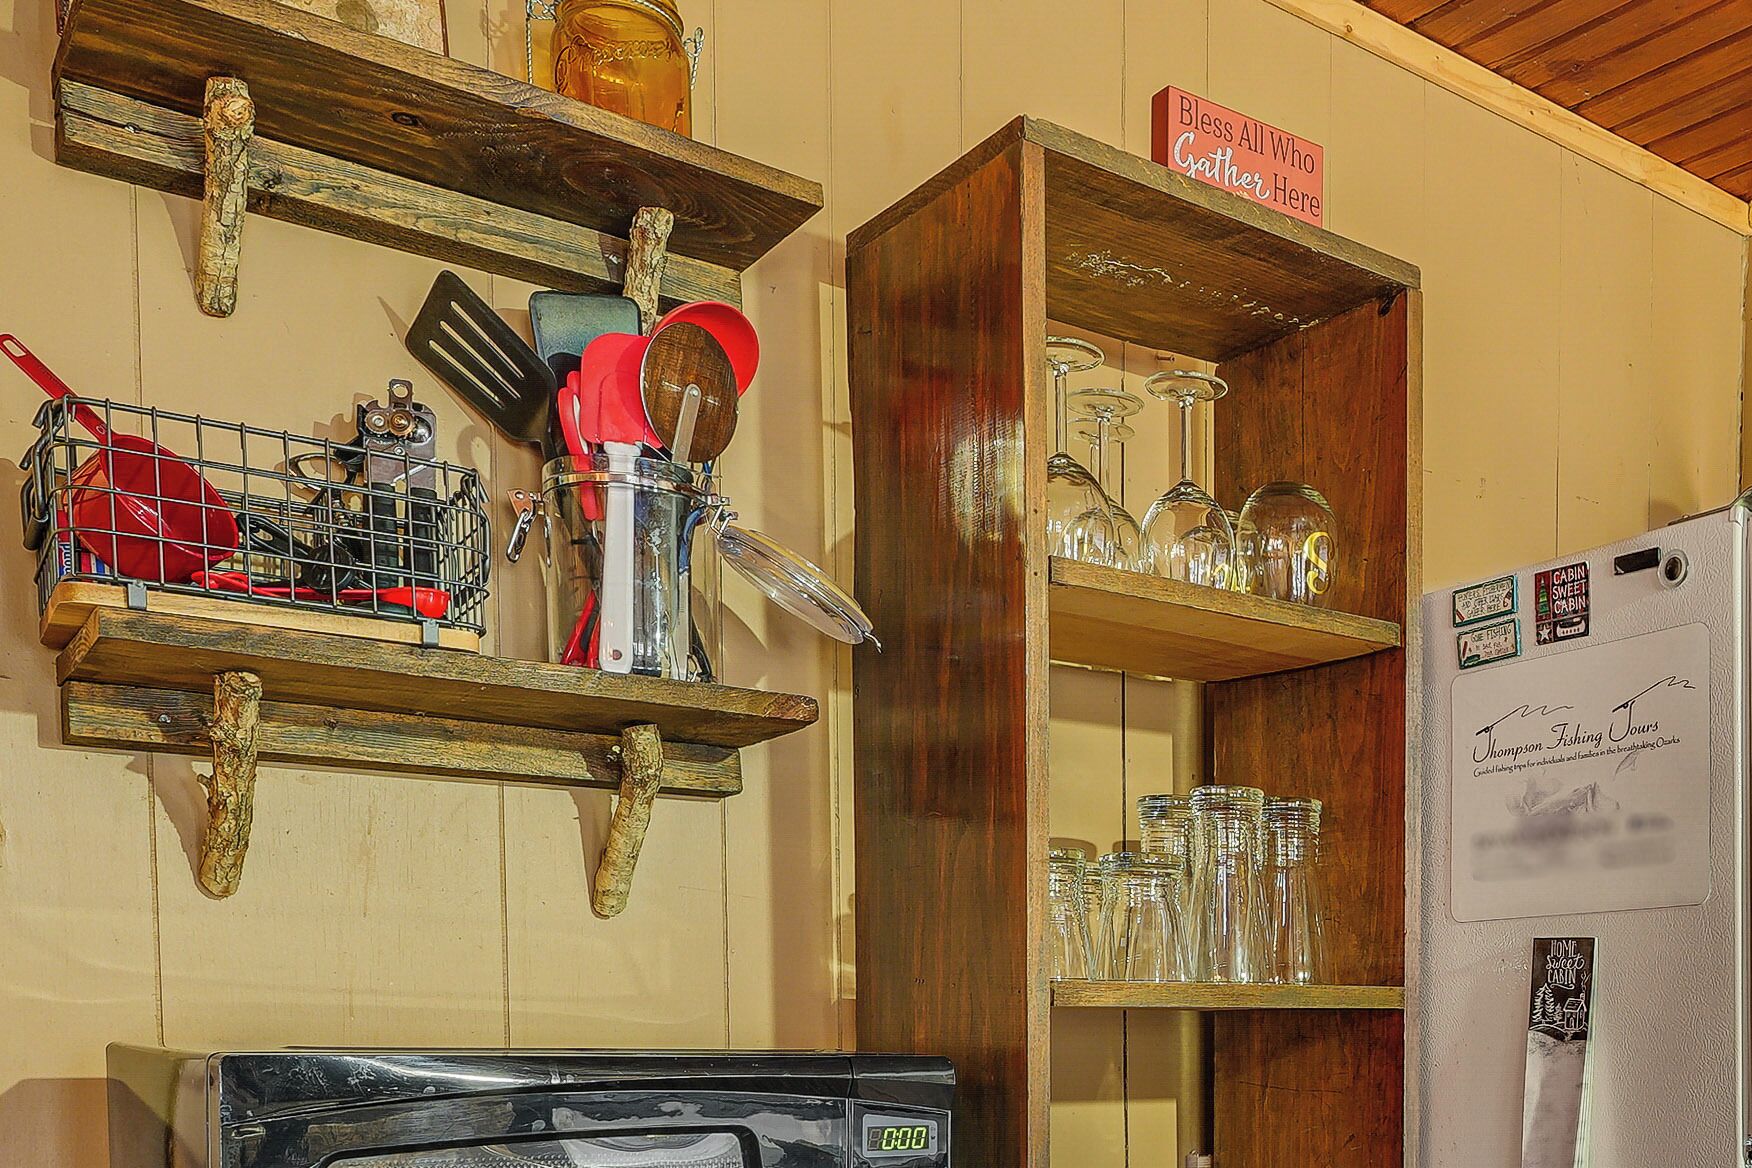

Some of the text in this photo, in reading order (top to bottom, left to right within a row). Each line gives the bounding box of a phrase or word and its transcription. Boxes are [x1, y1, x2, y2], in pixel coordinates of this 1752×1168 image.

[1179, 95, 1315, 174] Bless All Who
[1173, 131, 1320, 217] Gather Here
[1553, 565, 1585, 585] CABIN
[1552, 579, 1587, 600] SWEET
[1554, 595, 1586, 614] CABIN
[1472, 700, 1659, 763] Thompson Fishing Tours
[1473, 765, 1494, 777] Guided
[1527, 759, 1536, 768] for
[1536, 754, 1565, 766] individuals
[1566, 751, 1577, 762] and
[1606, 746, 1616, 755] the
[1616, 740, 1656, 752] breathtaking
[1655, 735, 1681, 748] Ozarks
[1550, 940, 1577, 958] HOME
[1547, 968, 1577, 985] CABIN
[881, 1126, 927, 1150] 0:00
